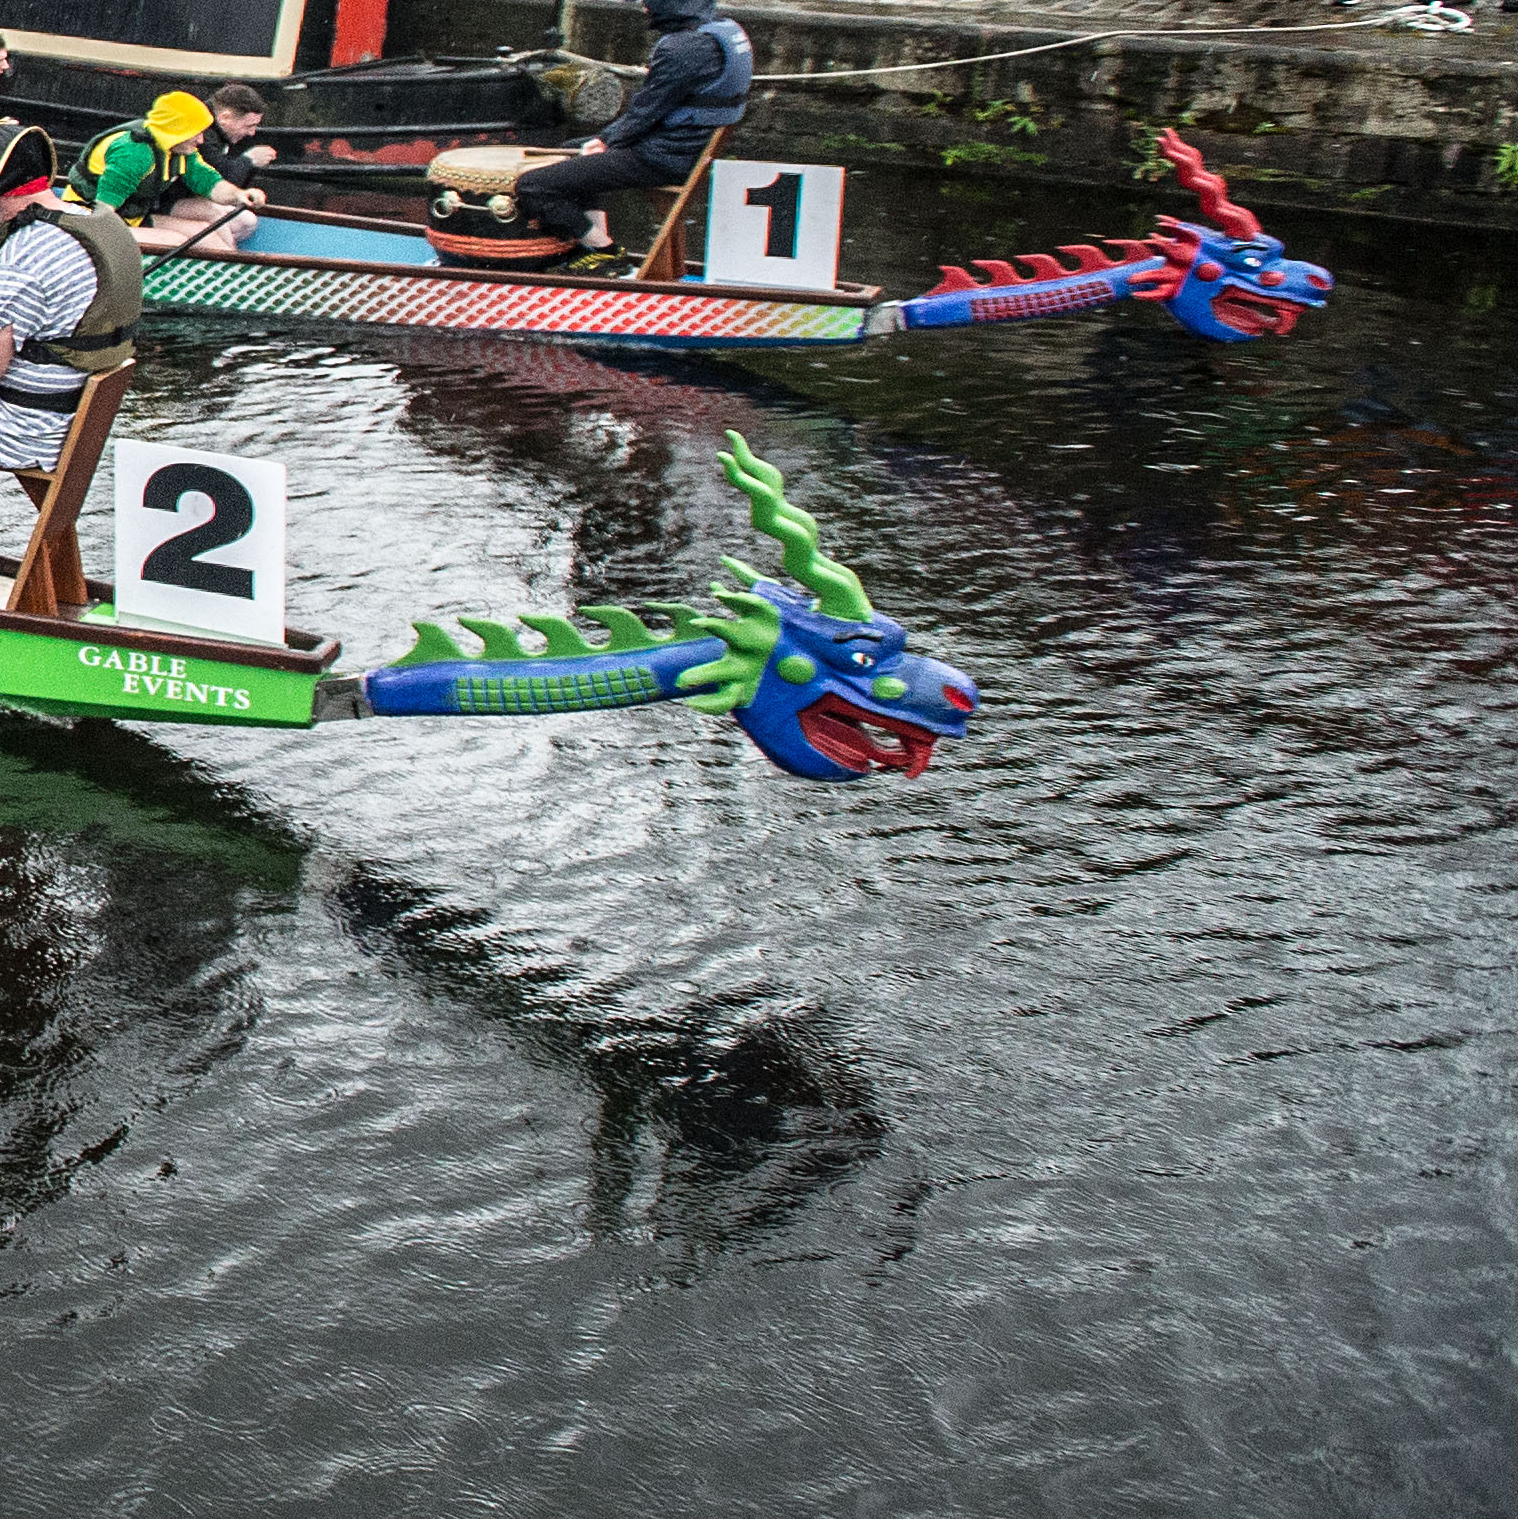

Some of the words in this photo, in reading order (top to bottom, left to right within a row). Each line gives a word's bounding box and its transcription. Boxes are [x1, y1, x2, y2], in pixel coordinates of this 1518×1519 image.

[745, 172, 804, 259] 1
[141, 462, 255, 600] 2
[78, 646, 187, 679] GABLE
[123, 673, 251, 710] EVENTS
